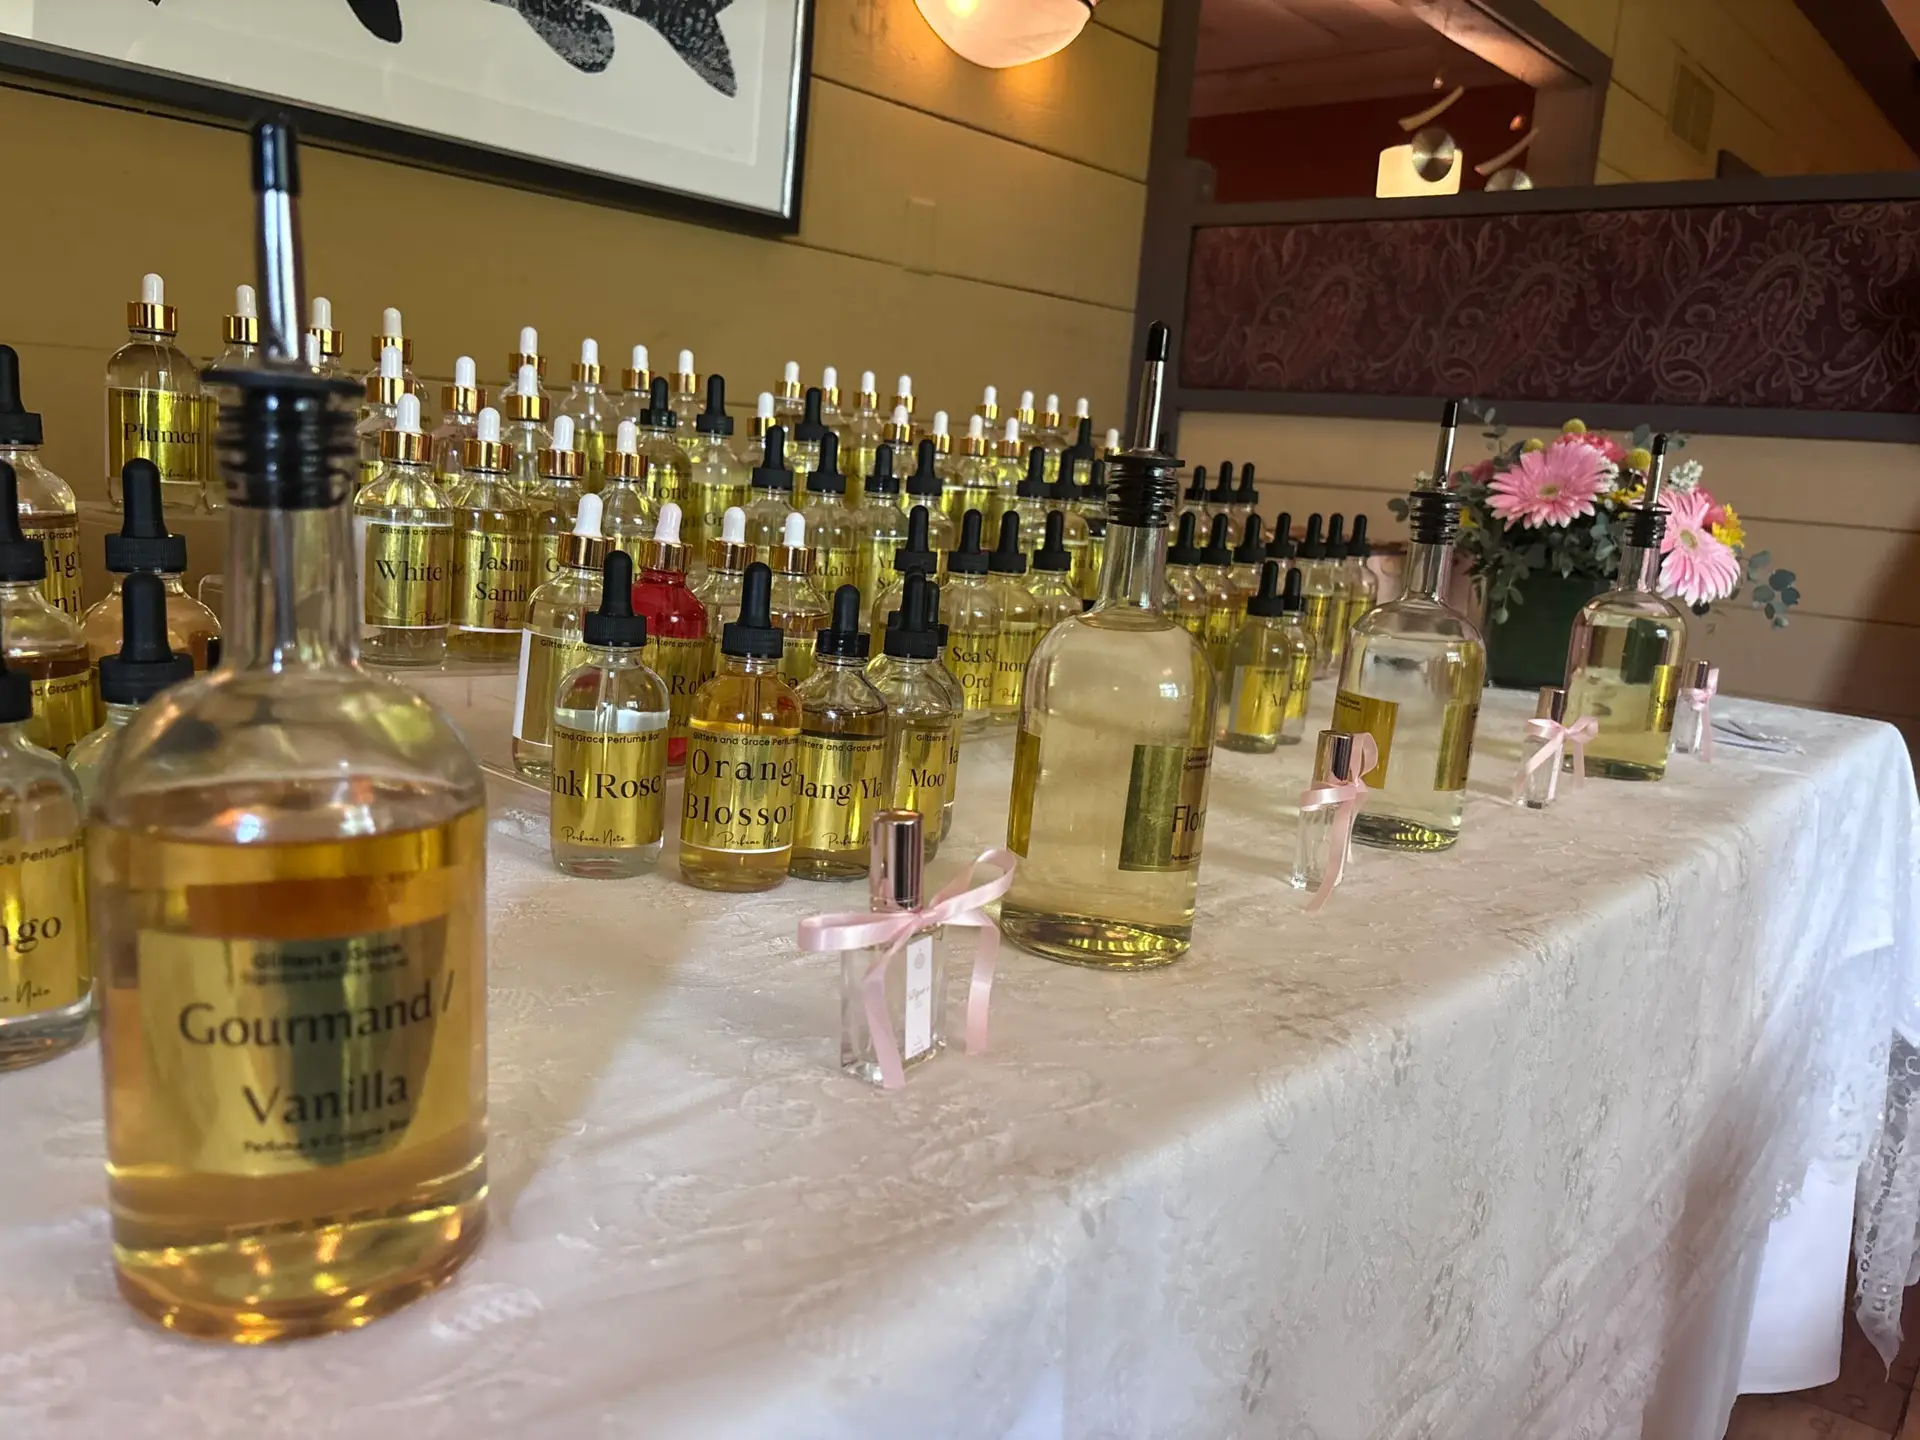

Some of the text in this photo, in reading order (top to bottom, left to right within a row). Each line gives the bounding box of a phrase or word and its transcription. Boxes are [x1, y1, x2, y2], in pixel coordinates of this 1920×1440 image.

[379, 526, 410, 536] Glitters
[412, 529, 429, 537] and
[375, 559, 443, 582] White
[540, 638, 571, 651] Glitters
[561, 731, 575, 742] and
[576, 733, 606, 745] Grace
[608, 734, 647, 745] Perfume
[720, 736, 740, 746] and
[741, 737, 770, 747] Grace
[826, 743, 844, 753] and
[846, 744, 871, 754] Grace
[561, 825, 600, 844] Perfume
[717, 830, 761, 848] Perfume
[21, 840, 74, 863] Perfume
[241, 1069, 408, 1126] Vanilla
